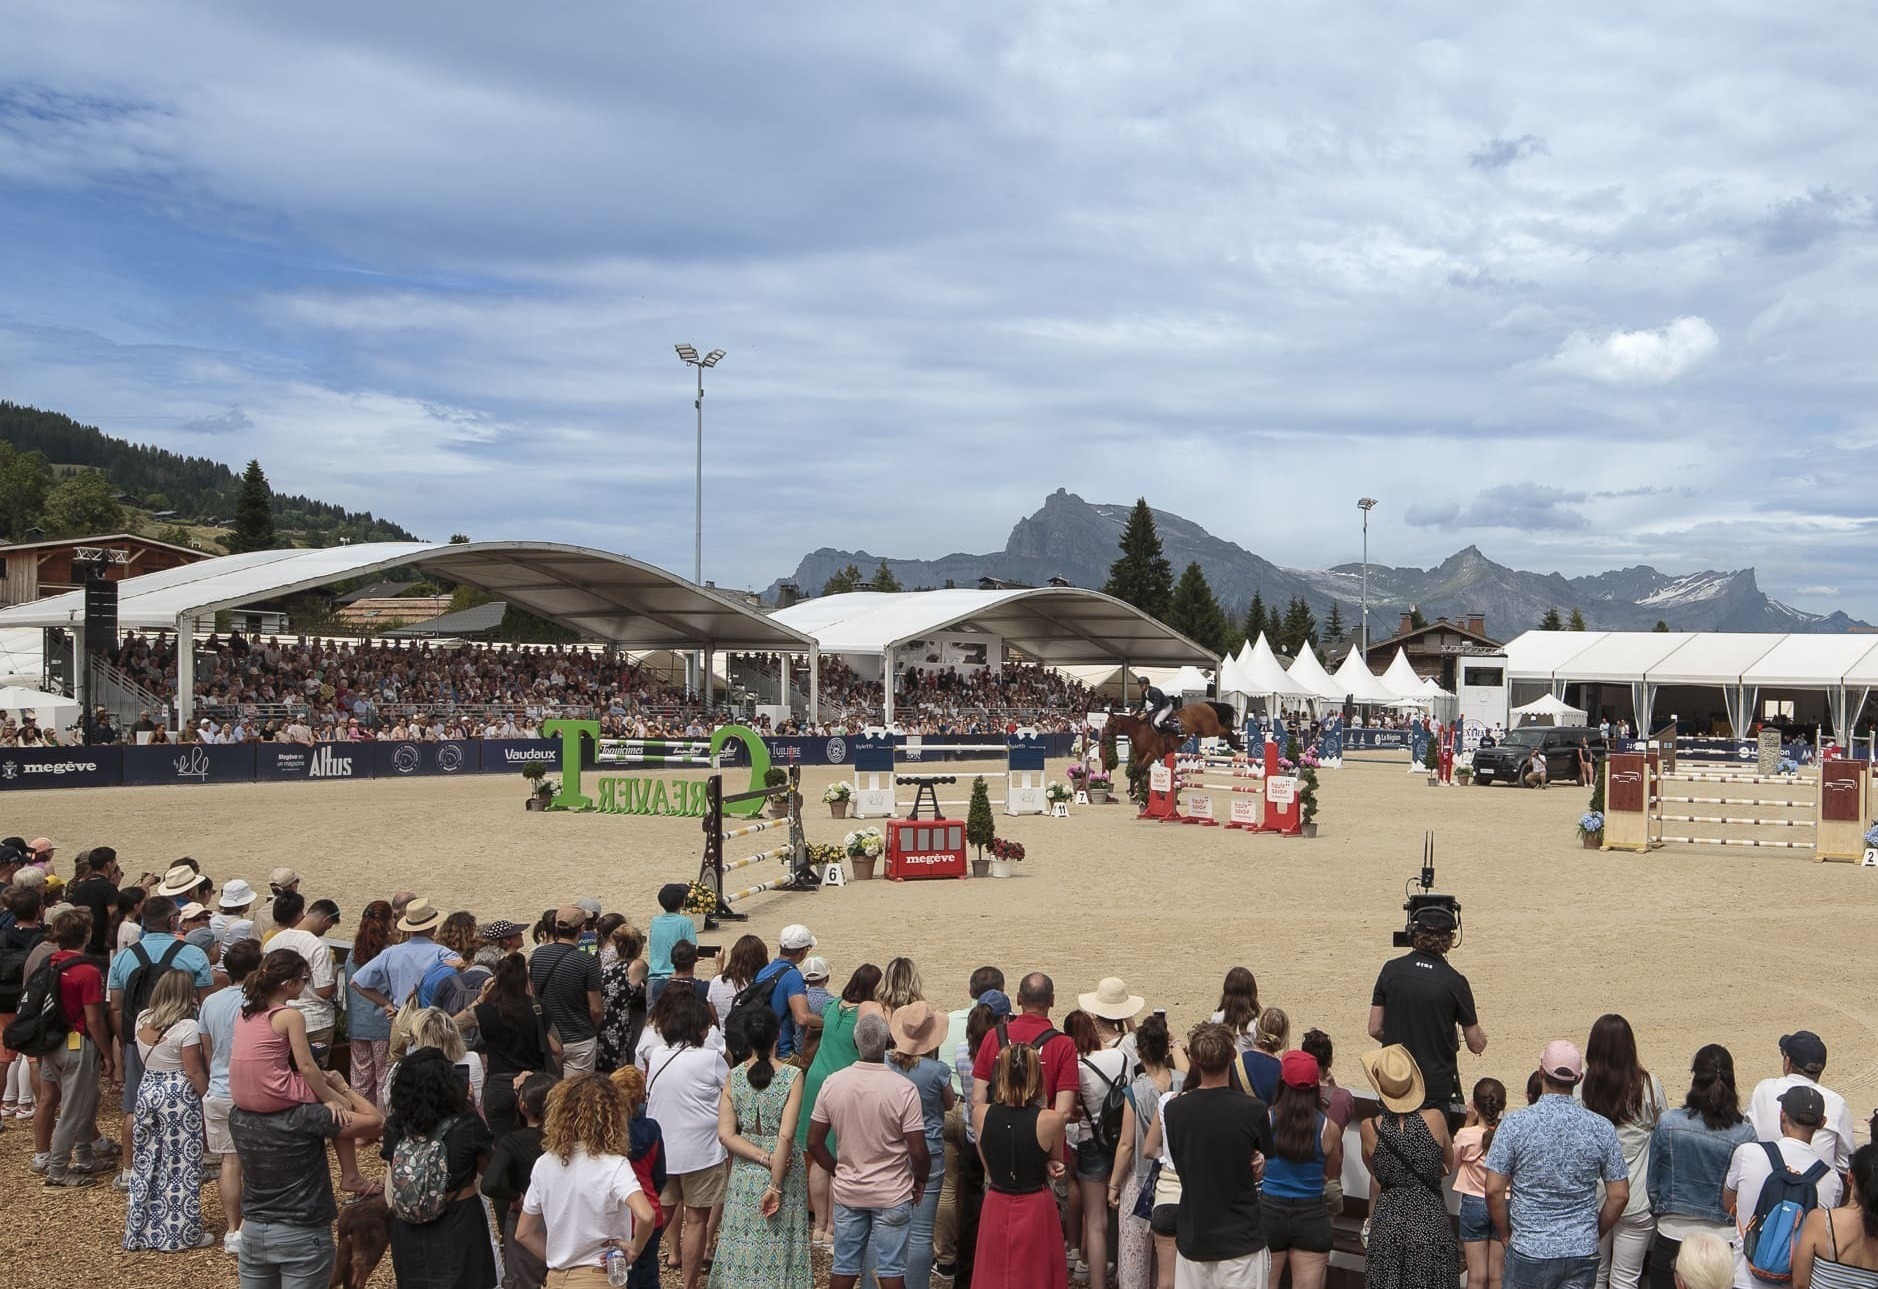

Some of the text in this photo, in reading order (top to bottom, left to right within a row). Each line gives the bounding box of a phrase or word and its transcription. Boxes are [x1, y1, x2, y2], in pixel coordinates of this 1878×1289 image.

[504, 748, 556, 760] Vaudaux
[309, 745, 352, 777] Altus
[23, 761, 96, 774] megève
[1079, 792, 1085, 801] 7
[1057, 804, 1066, 815] 11
[905, 853, 955, 865] megève
[1867, 851, 1874, 862] 2
[829, 867, 837, 881] 6
